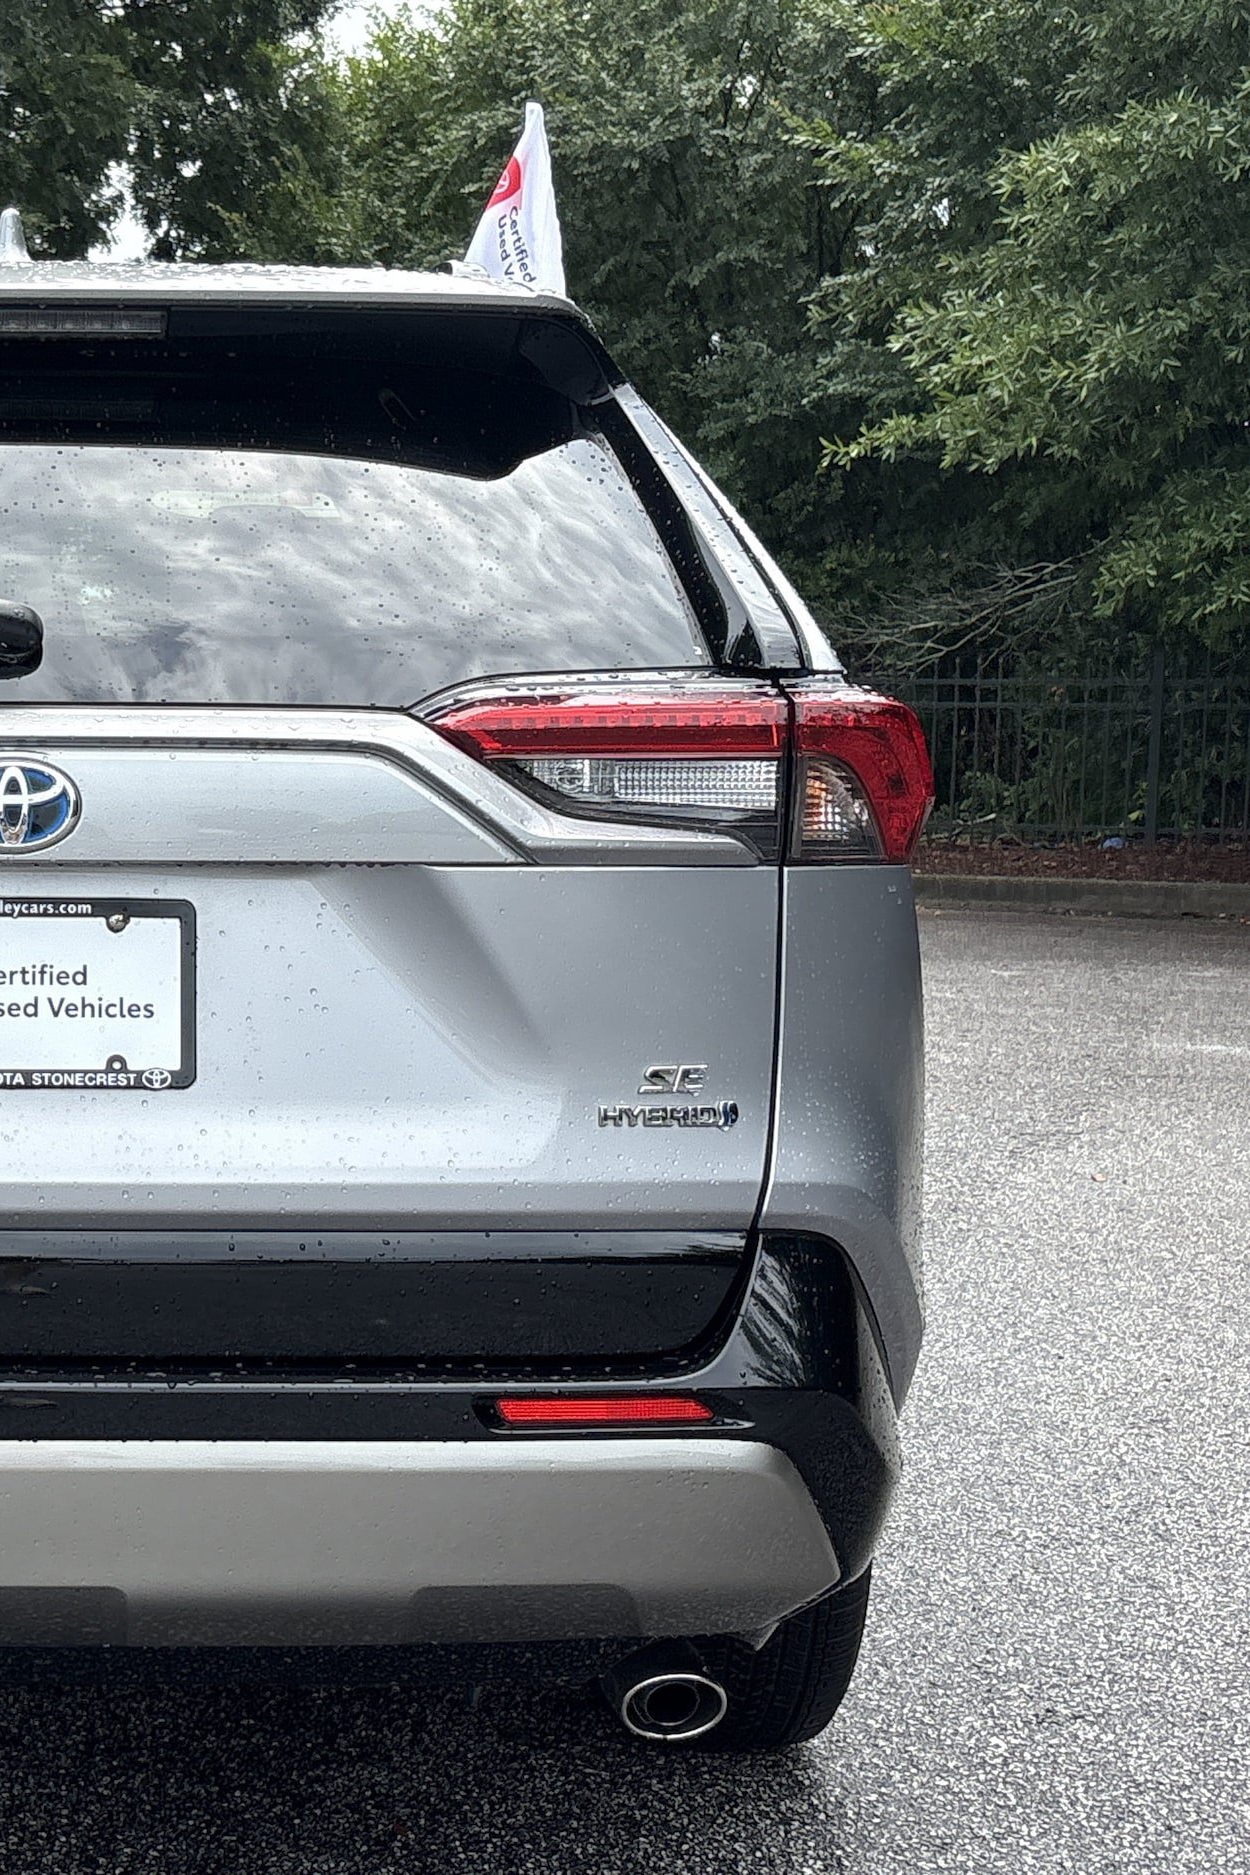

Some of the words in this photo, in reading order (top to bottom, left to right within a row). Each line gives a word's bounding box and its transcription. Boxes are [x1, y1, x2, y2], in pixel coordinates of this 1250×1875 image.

[498, 213, 511, 263] Used
[510, 205, 537, 283] Certified
[47, 996, 155, 1019] Vehicles
[31, 1072, 137, 1087] STONECREST
[638, 1064, 709, 1095] SE
[598, 1104, 719, 1128] HYBRID
